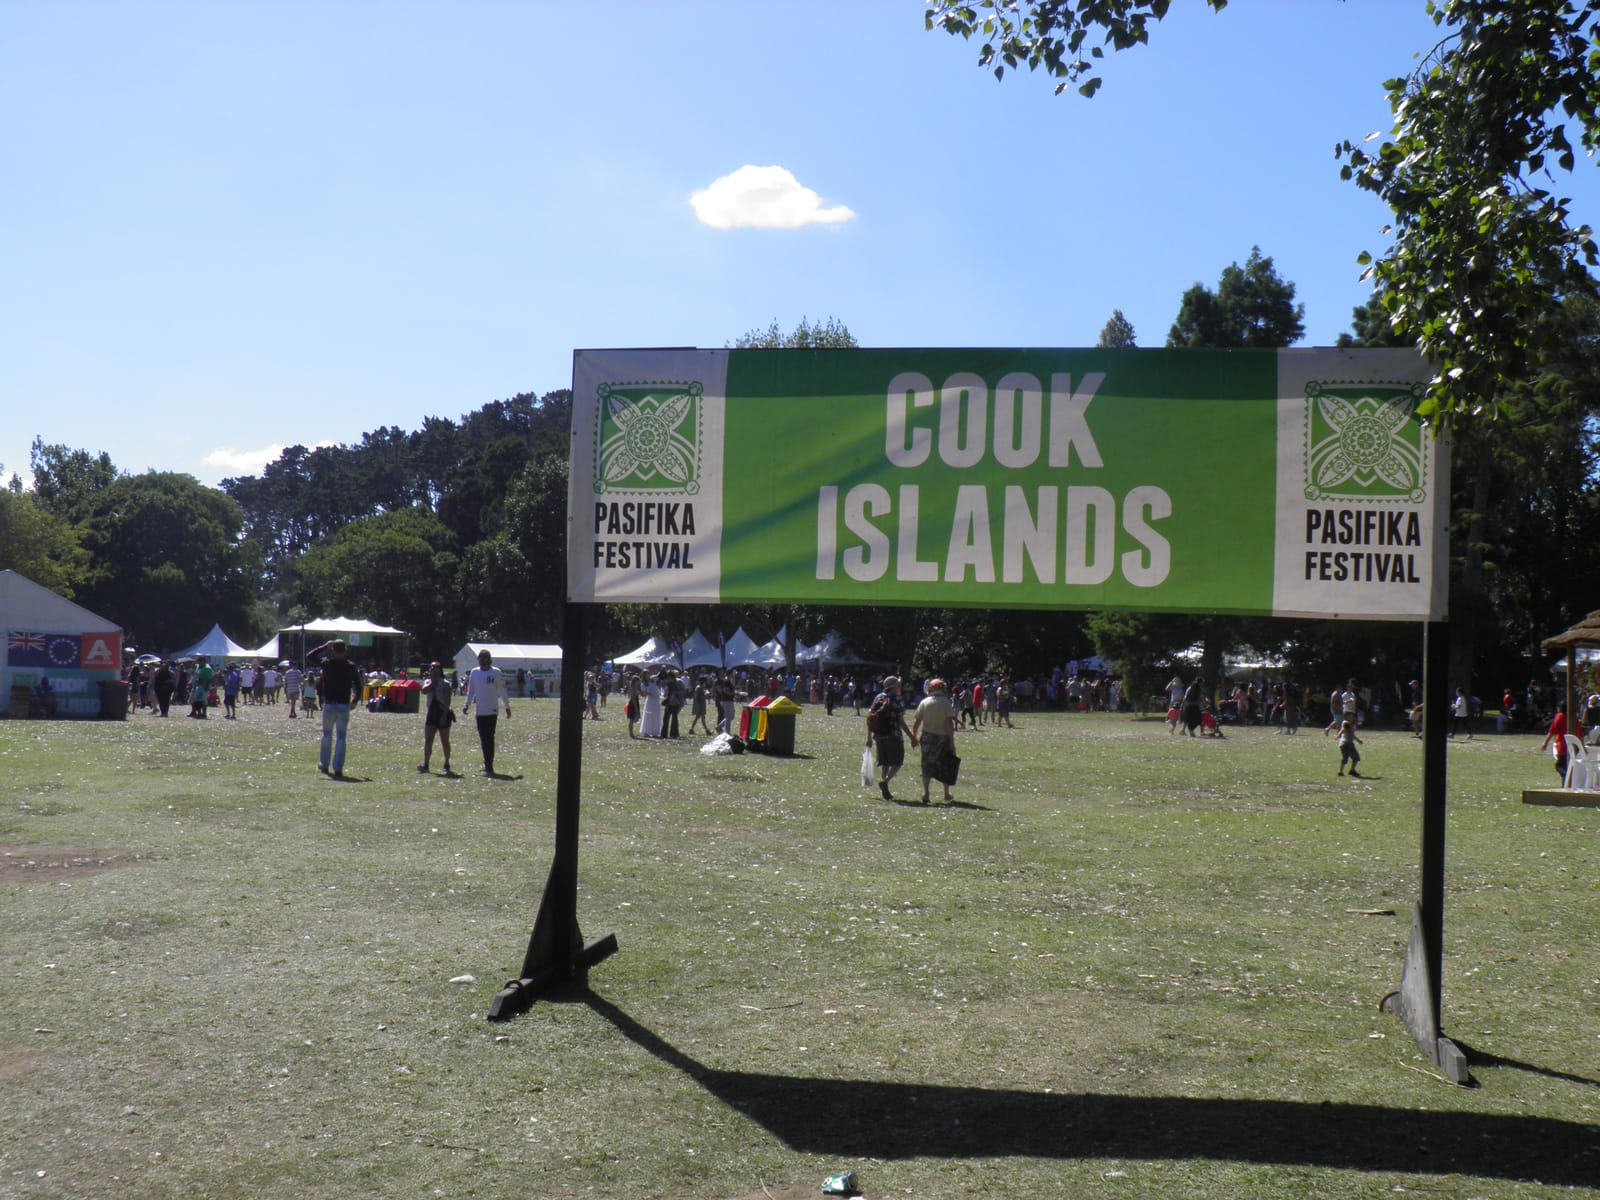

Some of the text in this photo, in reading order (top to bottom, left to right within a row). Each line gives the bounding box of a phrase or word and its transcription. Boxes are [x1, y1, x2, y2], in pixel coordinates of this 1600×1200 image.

[886, 372, 1106, 467] COOK
[595, 502, 695, 535] PASIFIKA
[816, 483, 1172, 587] ISLANDS
[1306, 509, 1421, 546] PASIFIKA
[594, 541, 693, 568] FESTIVAL
[1305, 551, 1420, 583] FESTIVAL
